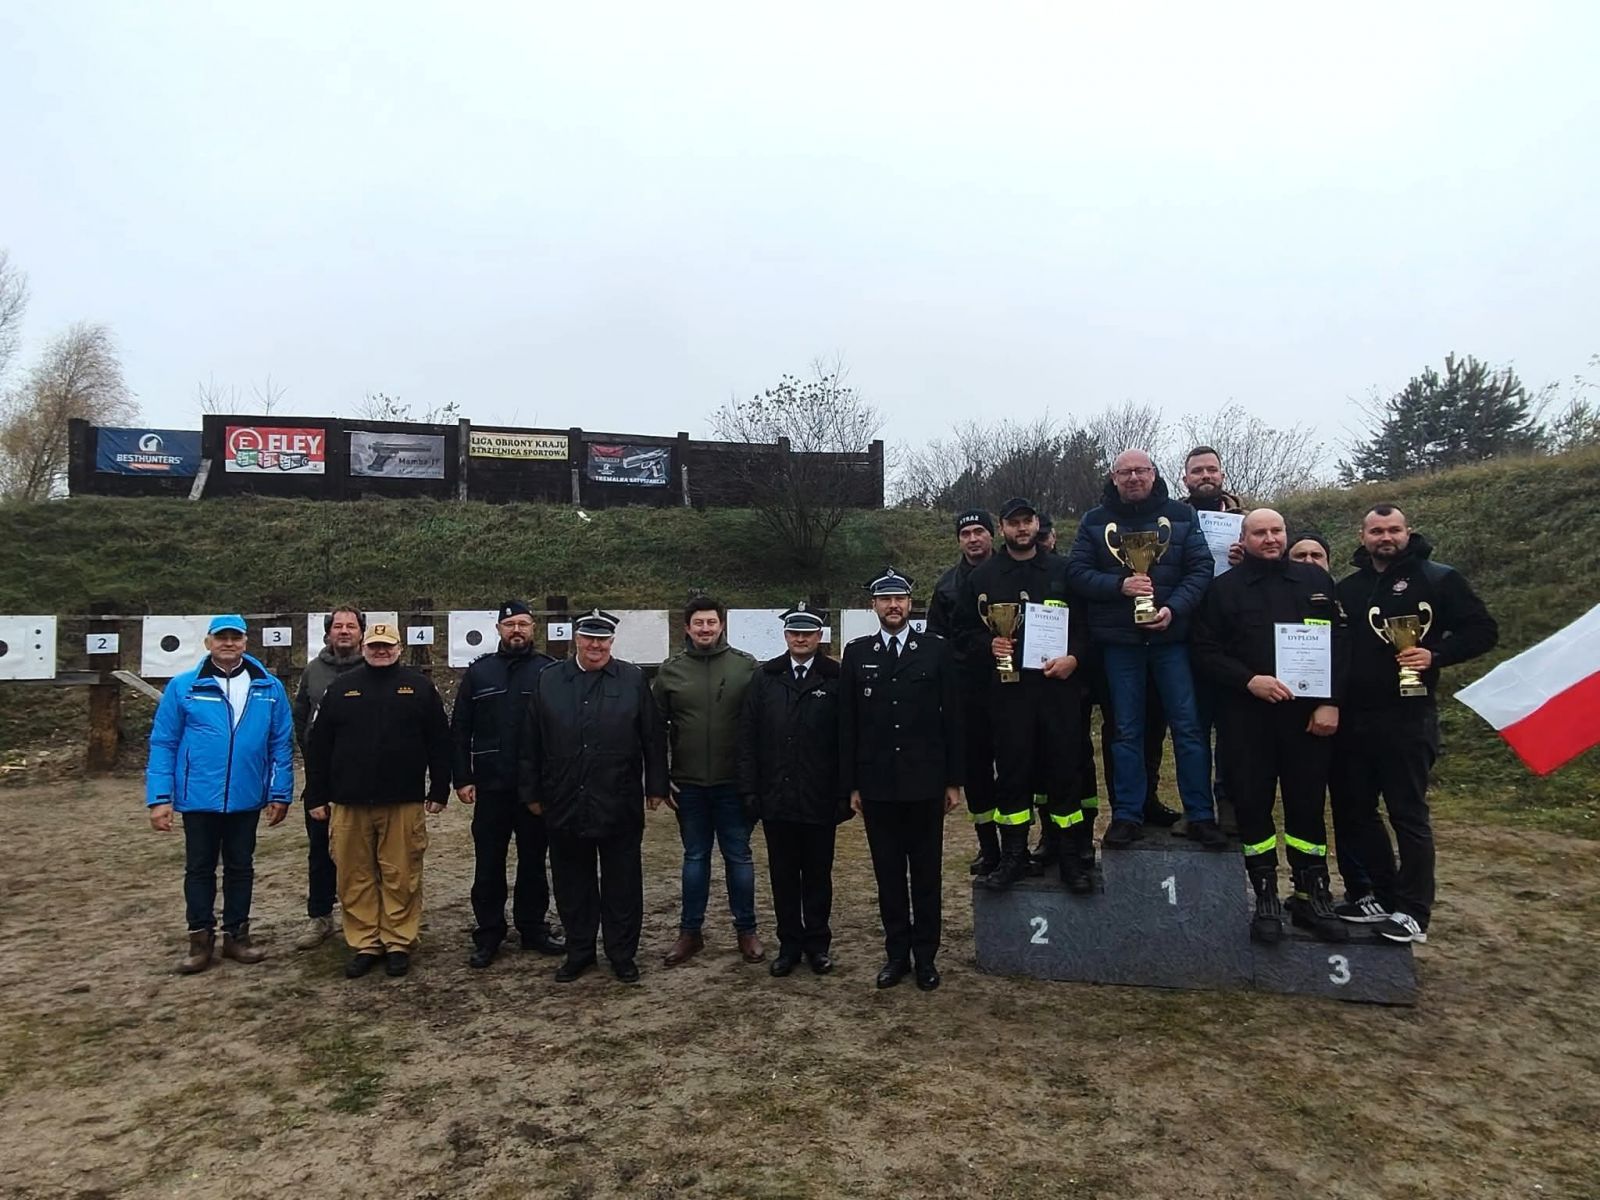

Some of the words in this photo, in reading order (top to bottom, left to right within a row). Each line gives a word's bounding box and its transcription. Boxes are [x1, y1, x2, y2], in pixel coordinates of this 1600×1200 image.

[268, 434, 321, 454] ELEY
[471, 437, 493, 446] LIGA
[495, 439, 533, 448] OBRONY
[535, 440, 567, 449] KRAJU
[471, 446, 521, 455] STRZELNICA
[523, 449, 566, 457] SPORTOWA
[116, 453, 181, 465] BESTHUNTERS
[1034, 613, 1060, 621] DYPLOM
[556, 626, 564, 637] 5
[915, 622, 922, 632] 8
[272, 631, 281, 643] 3
[416, 629, 425, 641] 4
[97, 637, 107, 650] 2
[1160, 874, 1177, 905] 1
[1030, 916, 1049, 944] 2
[1327, 953, 1351, 985] 3
